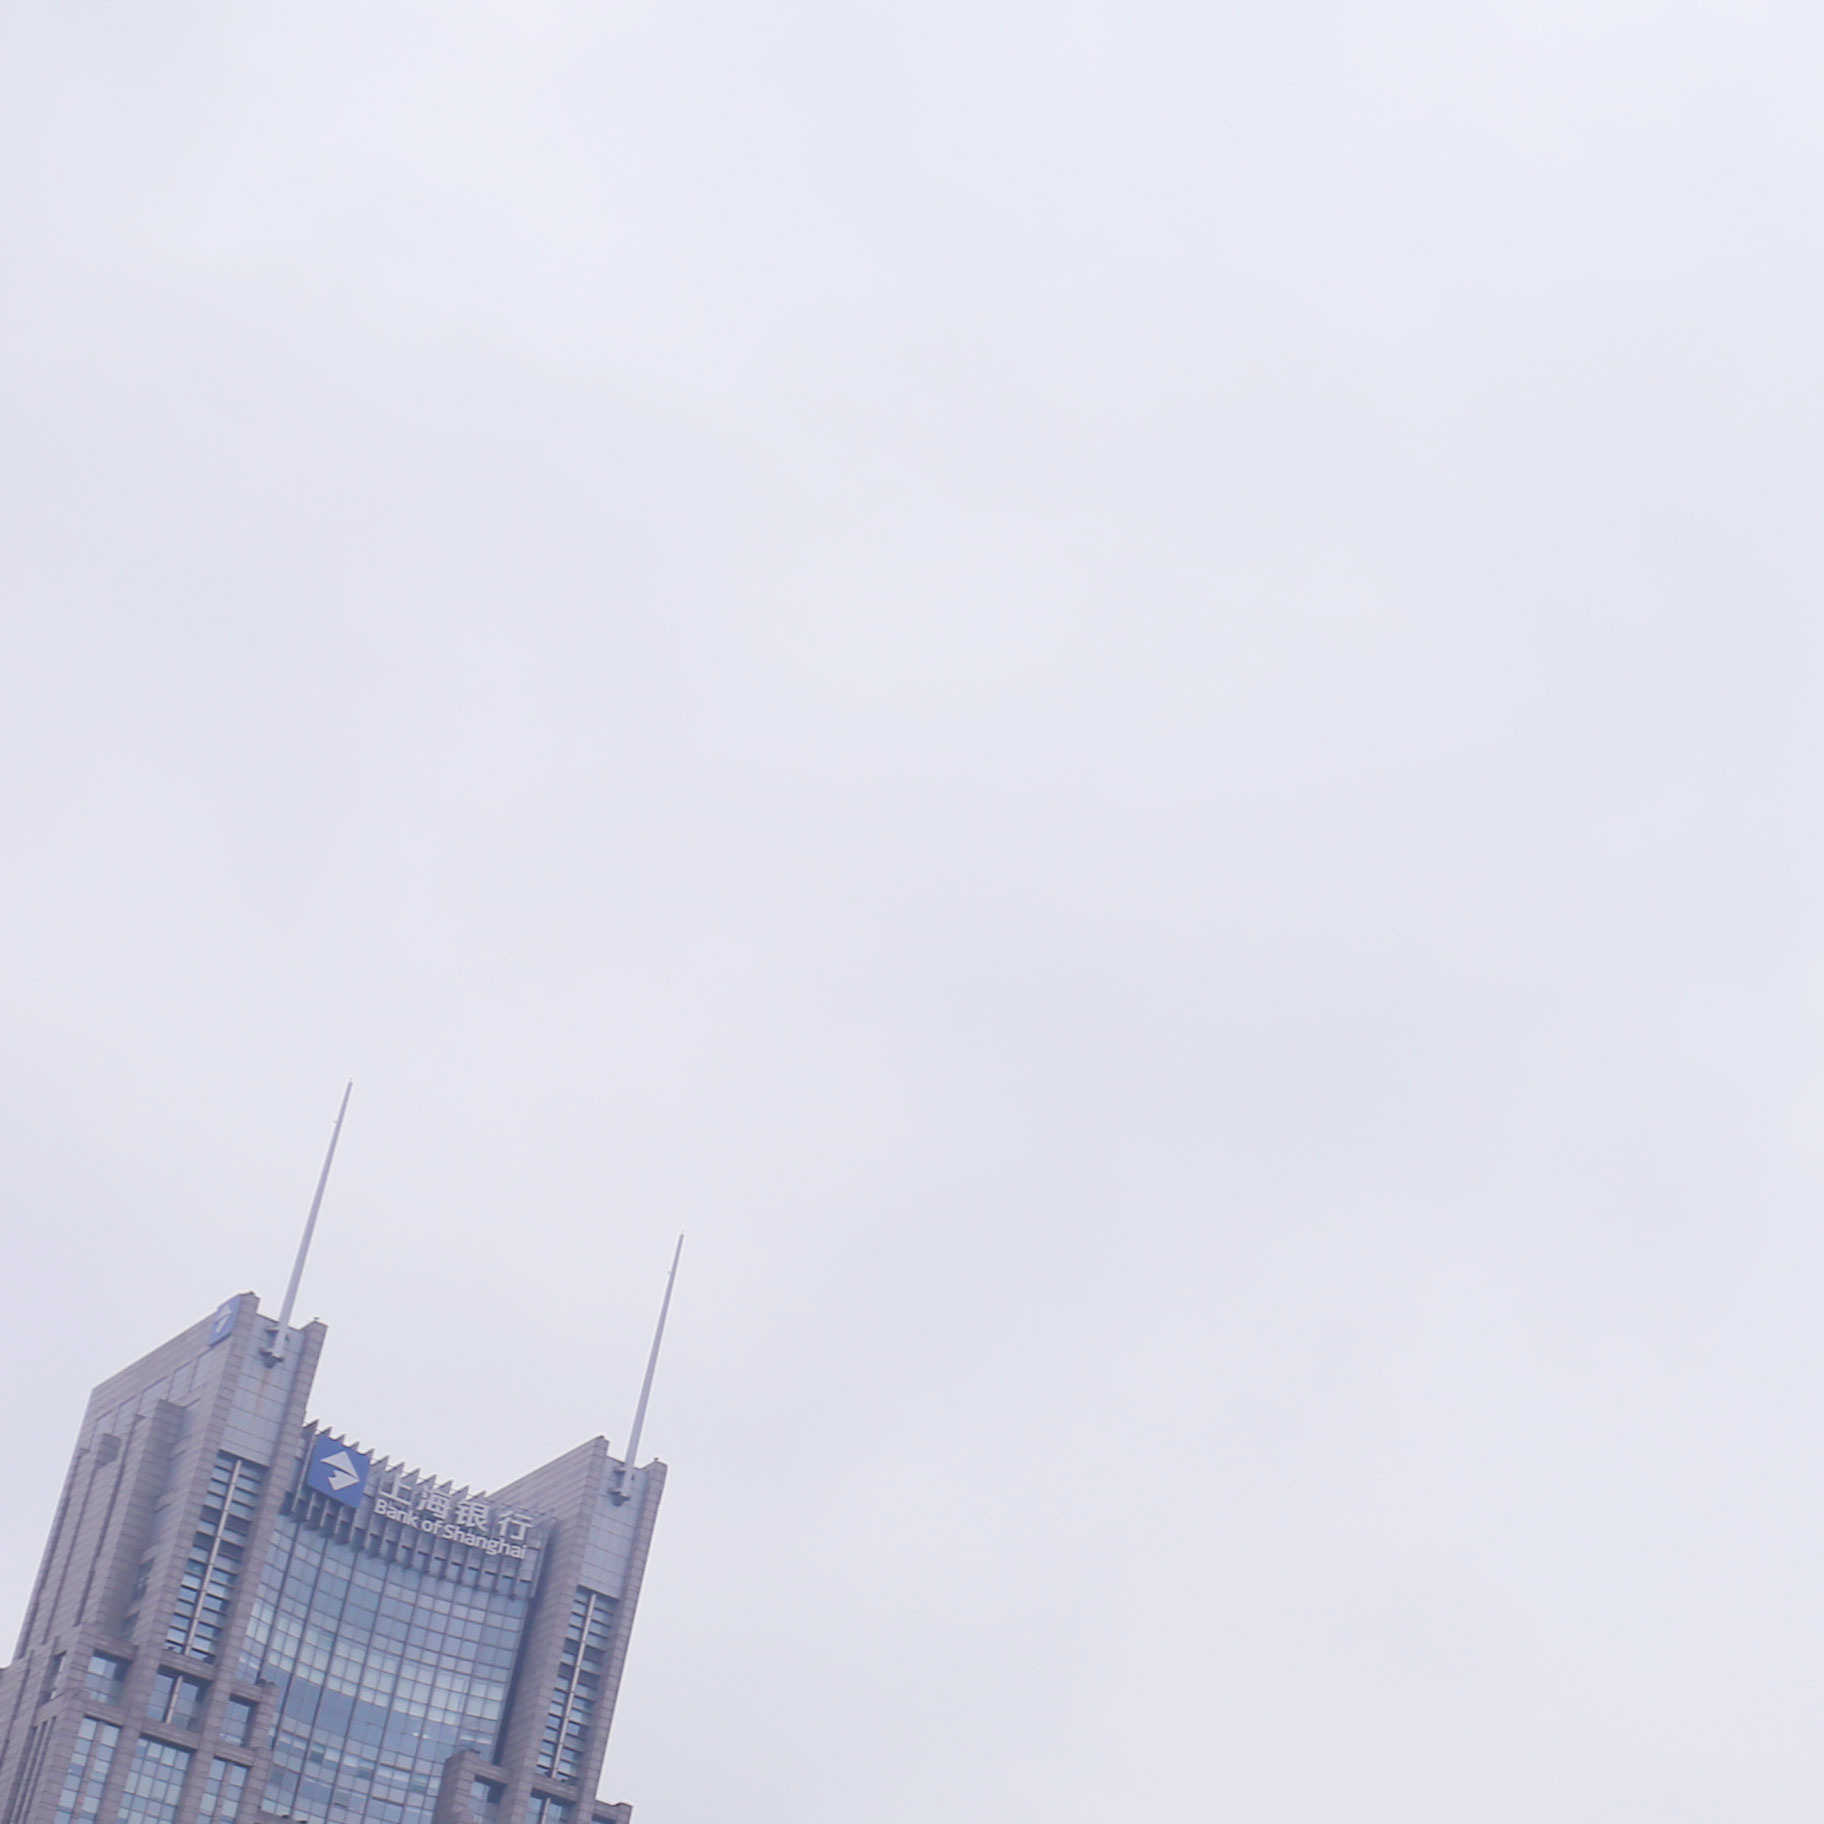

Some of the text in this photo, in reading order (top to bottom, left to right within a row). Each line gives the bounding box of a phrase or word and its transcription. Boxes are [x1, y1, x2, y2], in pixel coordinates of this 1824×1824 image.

[374, 1498, 528, 1560] Bank of Shanghai
[379, 1473, 533, 1541] 上海银行
